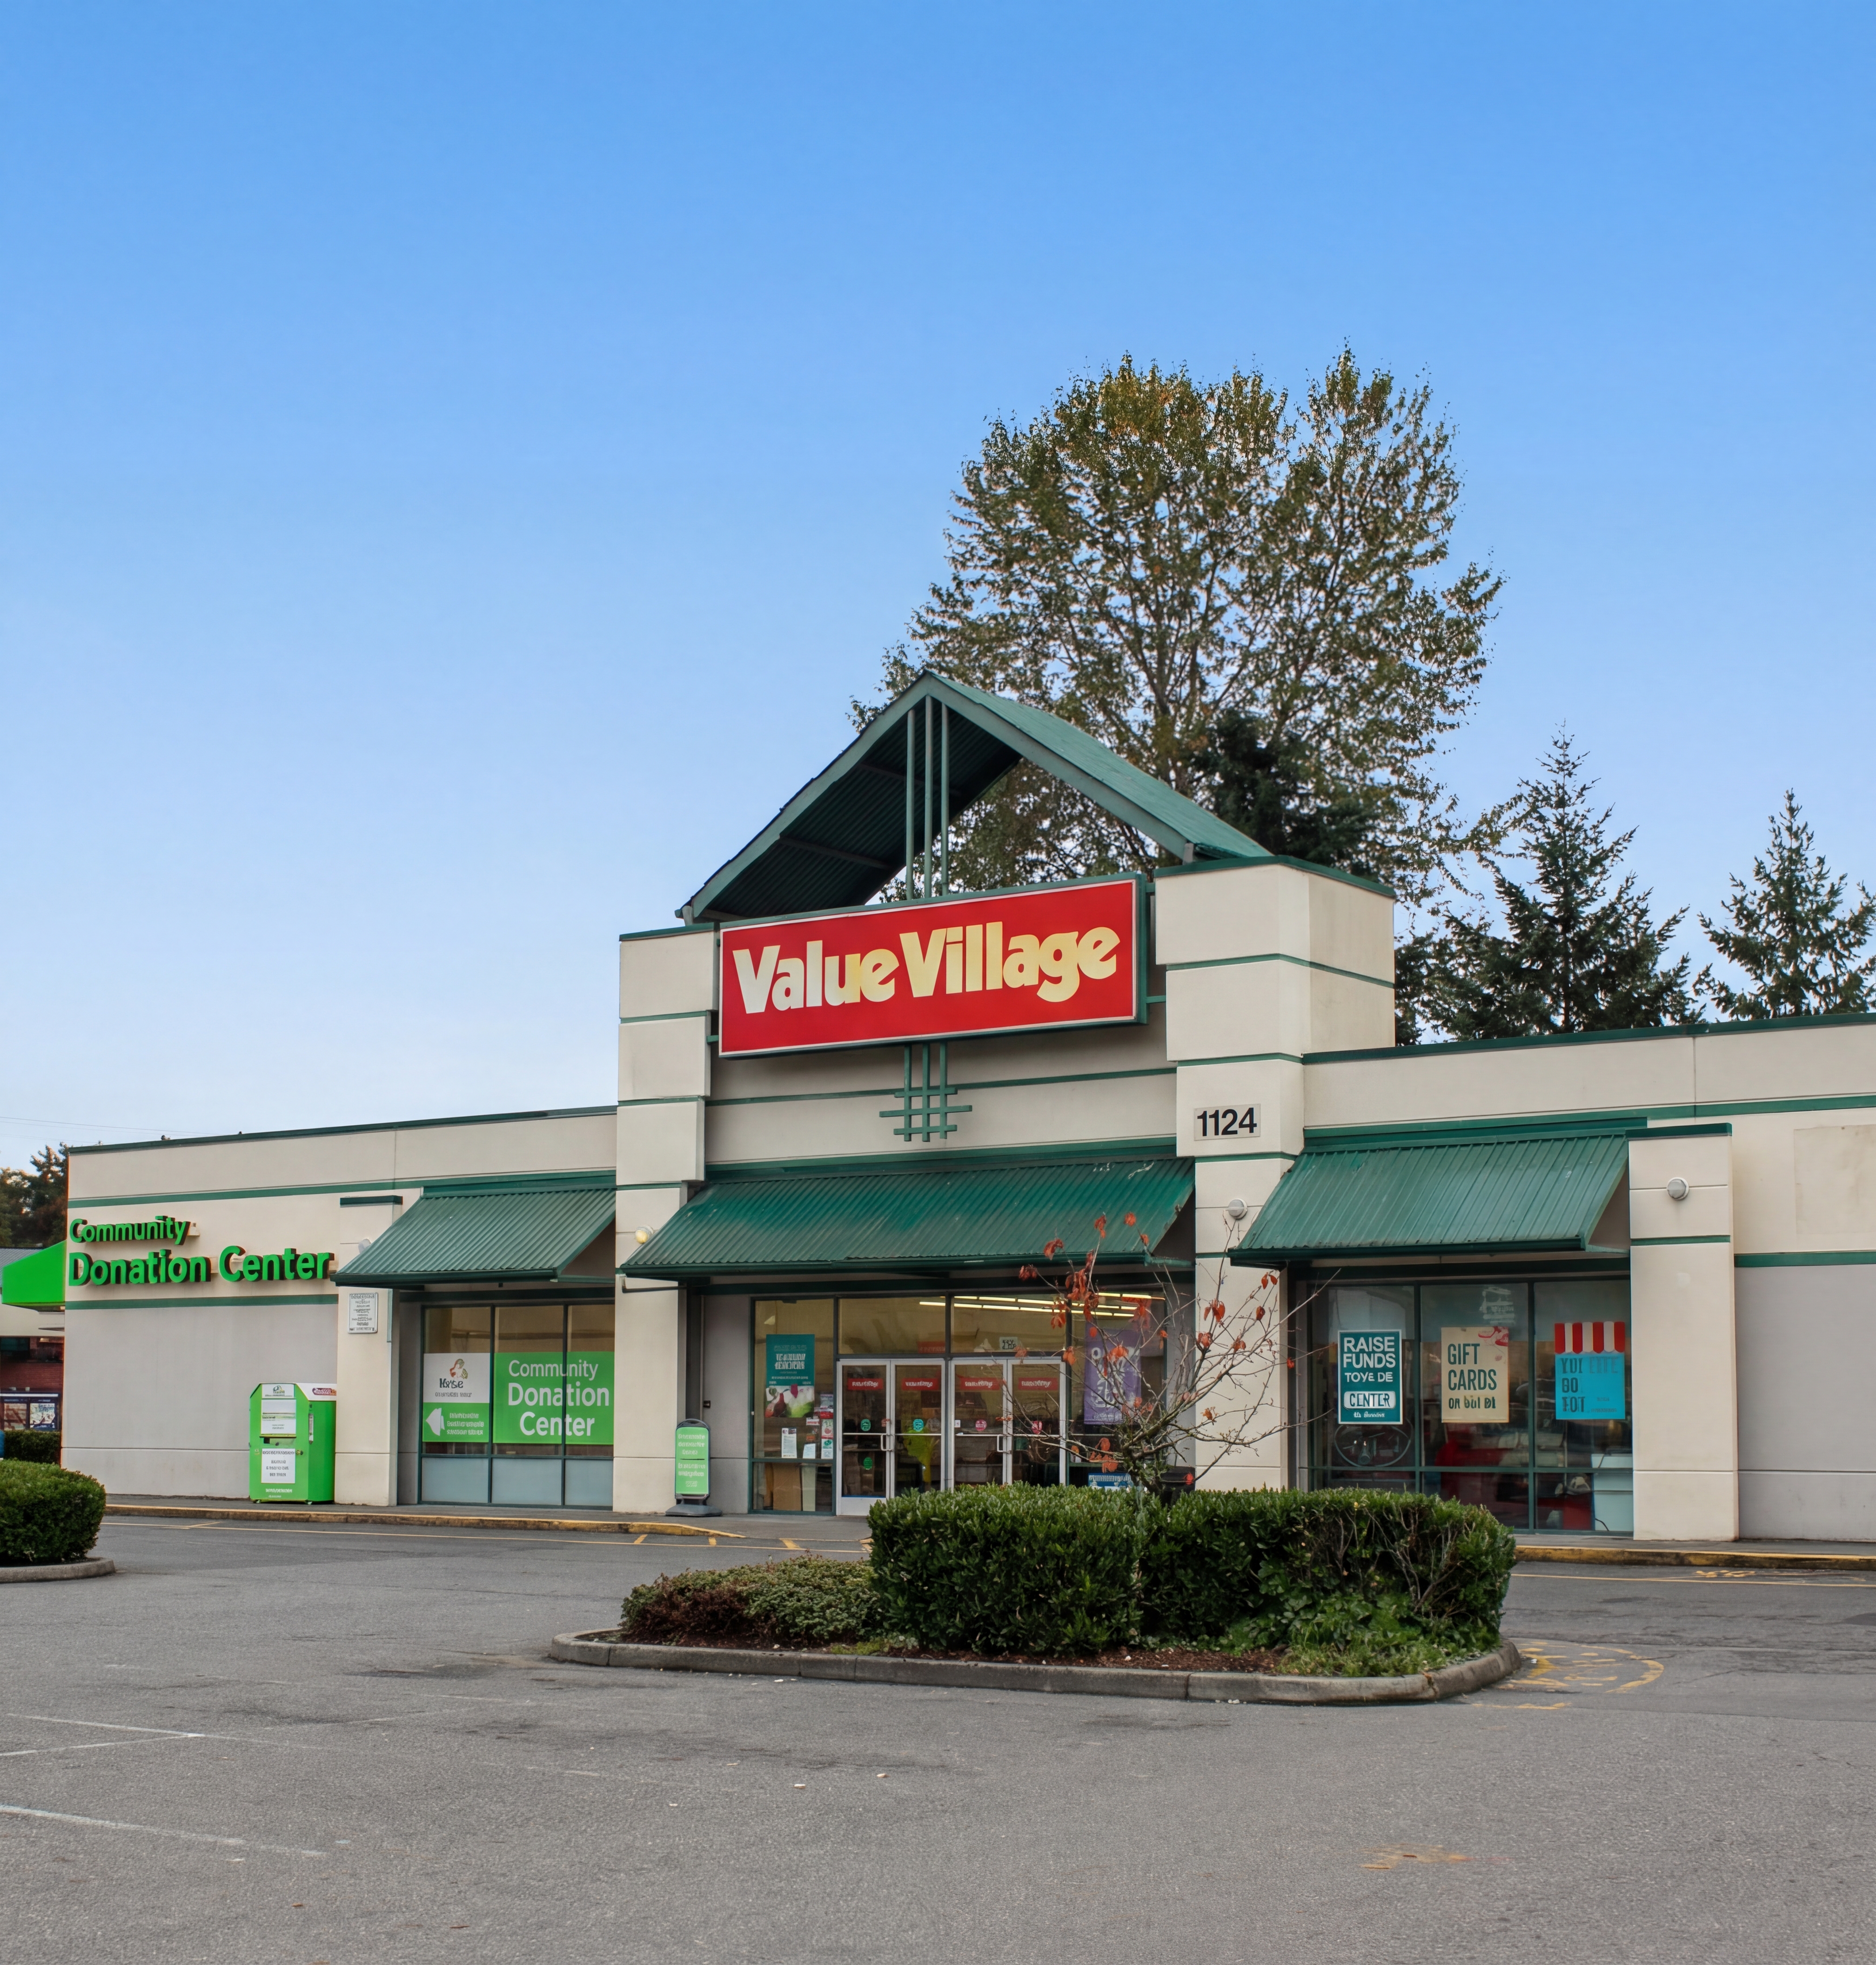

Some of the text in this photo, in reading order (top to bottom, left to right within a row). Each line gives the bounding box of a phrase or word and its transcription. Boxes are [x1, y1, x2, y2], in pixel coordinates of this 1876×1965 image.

[1197, 1107, 1257, 1137] 1124
[69, 1216, 190, 1246] Community
[68, 1245, 333, 1286] Donation Center
[1344, 1337, 1395, 1352] RAISE
[1447, 1343, 1481, 1365] GIFT
[509, 1359, 599, 1381] Community
[1343, 1353, 1396, 1369] FUNDS
[1448, 1369, 1497, 1391] CARDS
[508, 1381, 610, 1406] Donation
[1350, 1393, 1391, 1407] CENTER
[520, 1411, 595, 1437] Center
